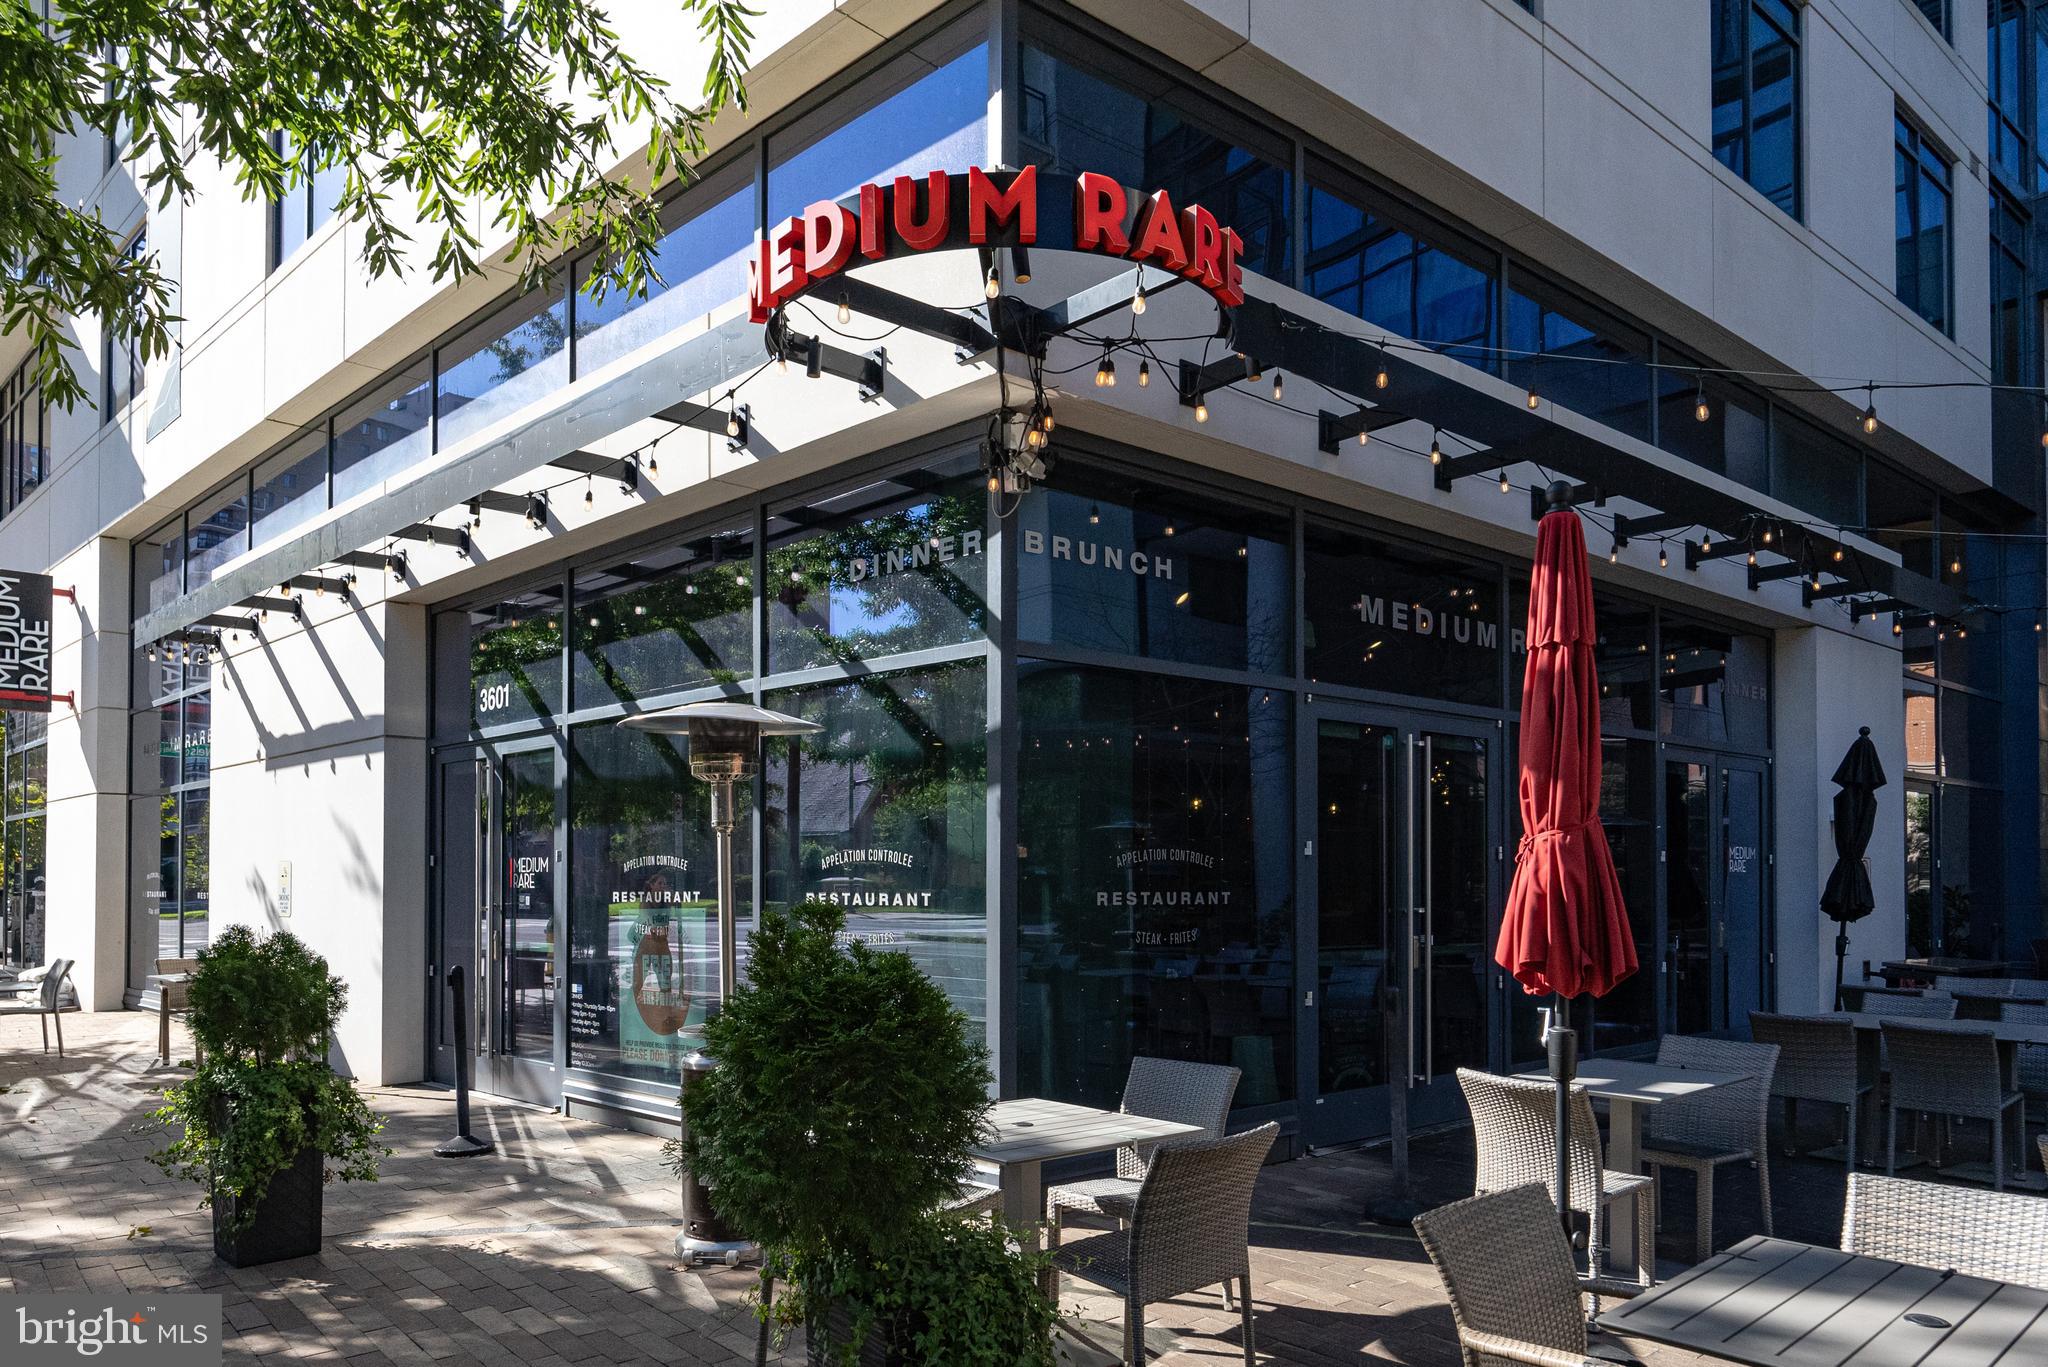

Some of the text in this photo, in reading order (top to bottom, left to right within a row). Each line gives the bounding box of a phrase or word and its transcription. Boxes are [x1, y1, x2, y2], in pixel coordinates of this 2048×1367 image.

[748, 165, 1244, 324] MEDIUM RARE
[849, 530, 1173, 582] DINNER BRUNCH
[1361, 594, 1497, 650] MEDIUM
[0, 576, 20, 690] MEDIUM
[20, 618, 49, 691] RARE
[480, 683, 510, 712] 3601
[1717, 678, 1767, 701] DINNER
[821, 848, 914, 870] APPELATION CONTROLEE
[1116, 848, 1215, 869] APPELATION CONTROLEE
[1730, 846, 1756, 860] MEDIUM
[513, 857, 549, 873] MEDIUM
[623, 855, 689, 873] APPELATION CONTROLEE
[1730, 860, 1747, 873] RARE
[513, 873, 536, 889] RARE
[612, 891, 701, 903] RESTAURANT
[1096, 891, 1232, 907] RESTAURANT
[868, 932, 897, 946] FRITES
[1135, 929, 1197, 945] STEAK FRITES
